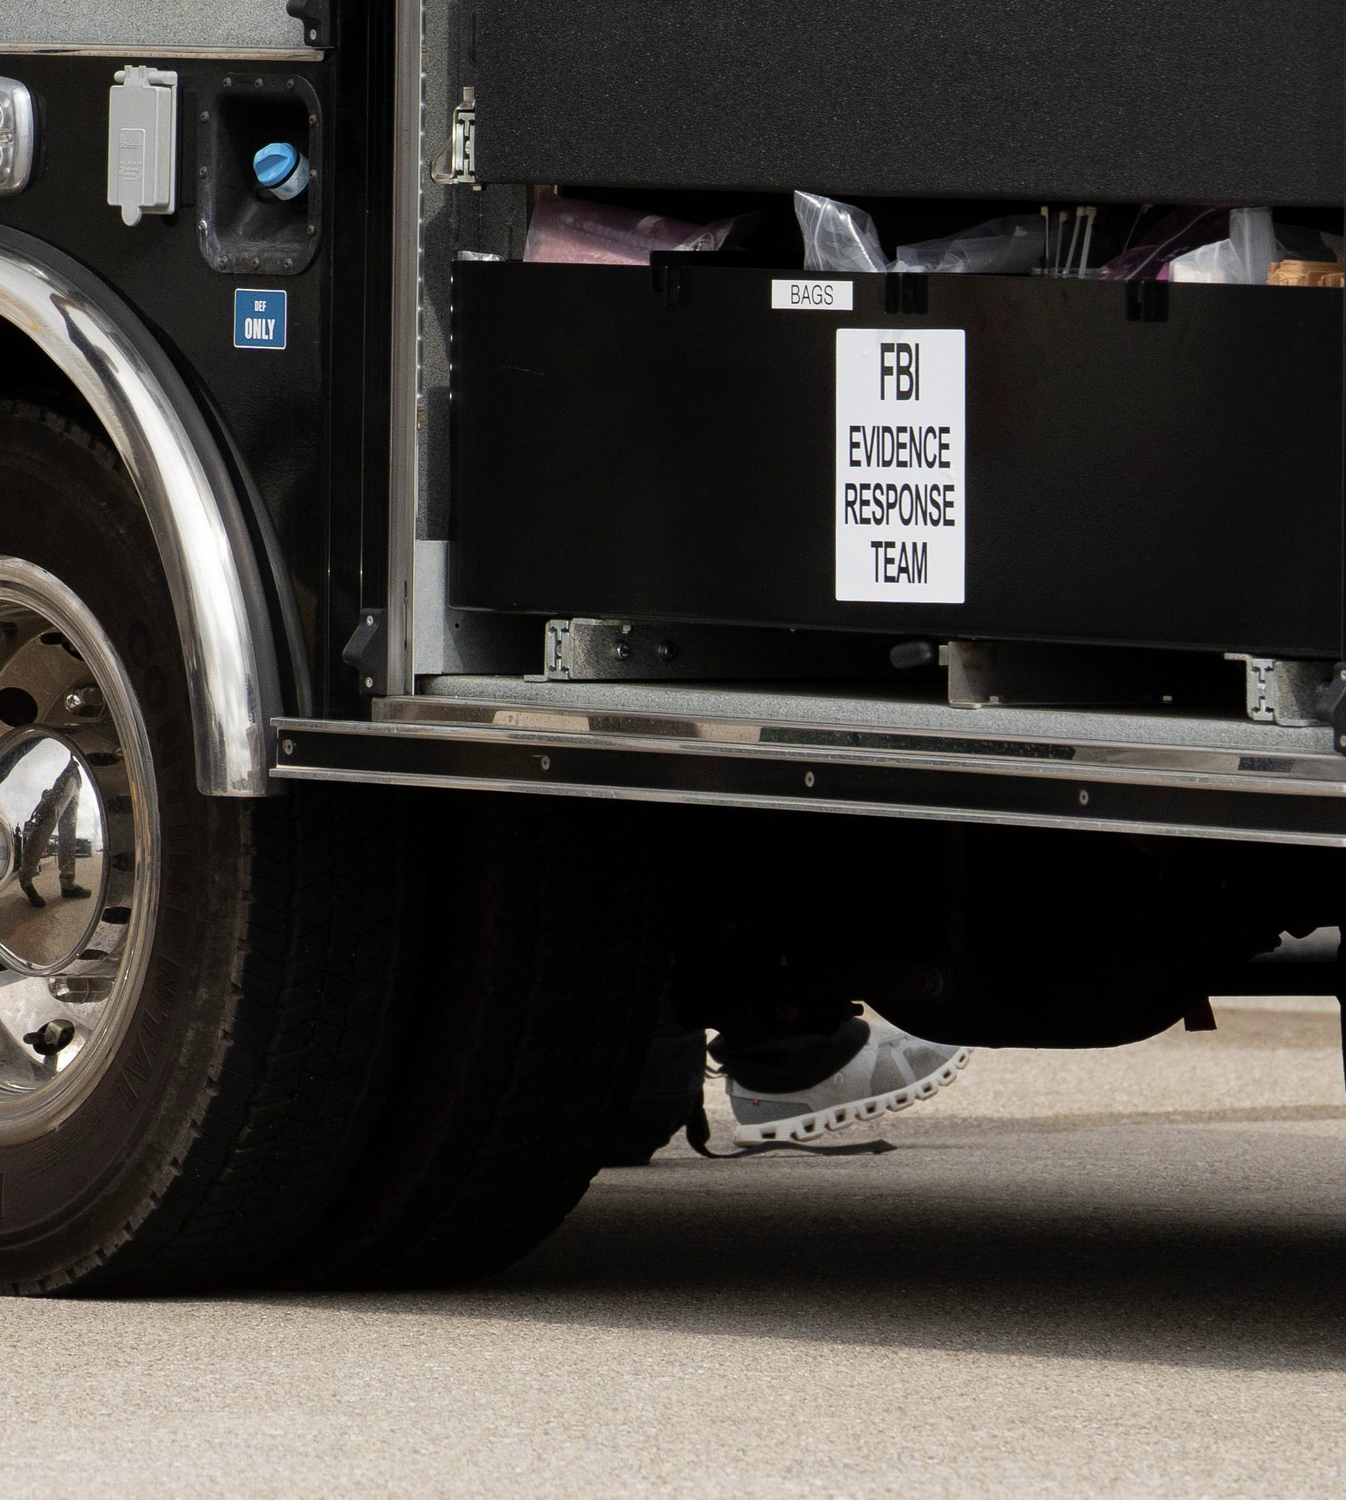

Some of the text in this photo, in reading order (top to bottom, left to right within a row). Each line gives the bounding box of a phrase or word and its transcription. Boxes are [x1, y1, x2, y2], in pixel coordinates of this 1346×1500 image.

[254, 300, 266, 311] DEF
[789, 284, 834, 306] BAGS
[244, 318, 275, 340] ONLY
[879, 342, 921, 402] FBI
[848, 425, 952, 469] EVIDENCE
[844, 483, 956, 527] RESPONSE
[870, 541, 928, 584] TEAM
